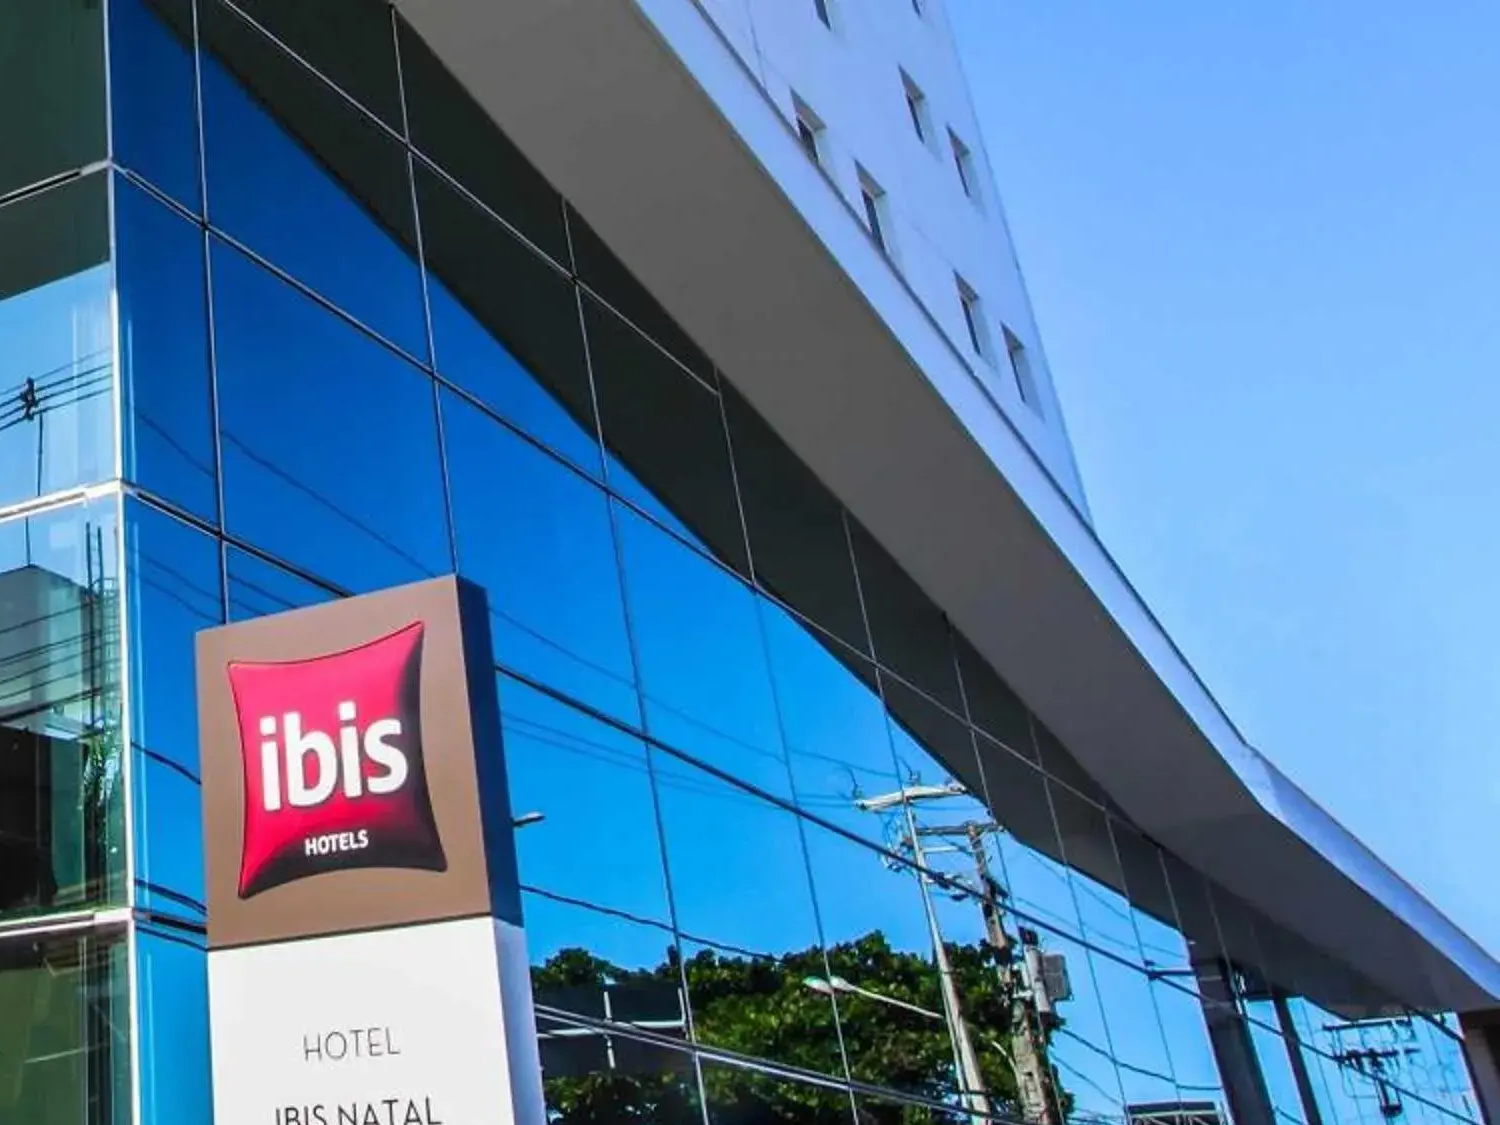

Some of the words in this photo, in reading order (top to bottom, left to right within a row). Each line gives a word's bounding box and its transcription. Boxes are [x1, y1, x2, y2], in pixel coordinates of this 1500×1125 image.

[260, 701, 408, 811] ibis
[305, 829, 369, 856] HOTELS
[303, 1027, 401, 1062] HOTEL
